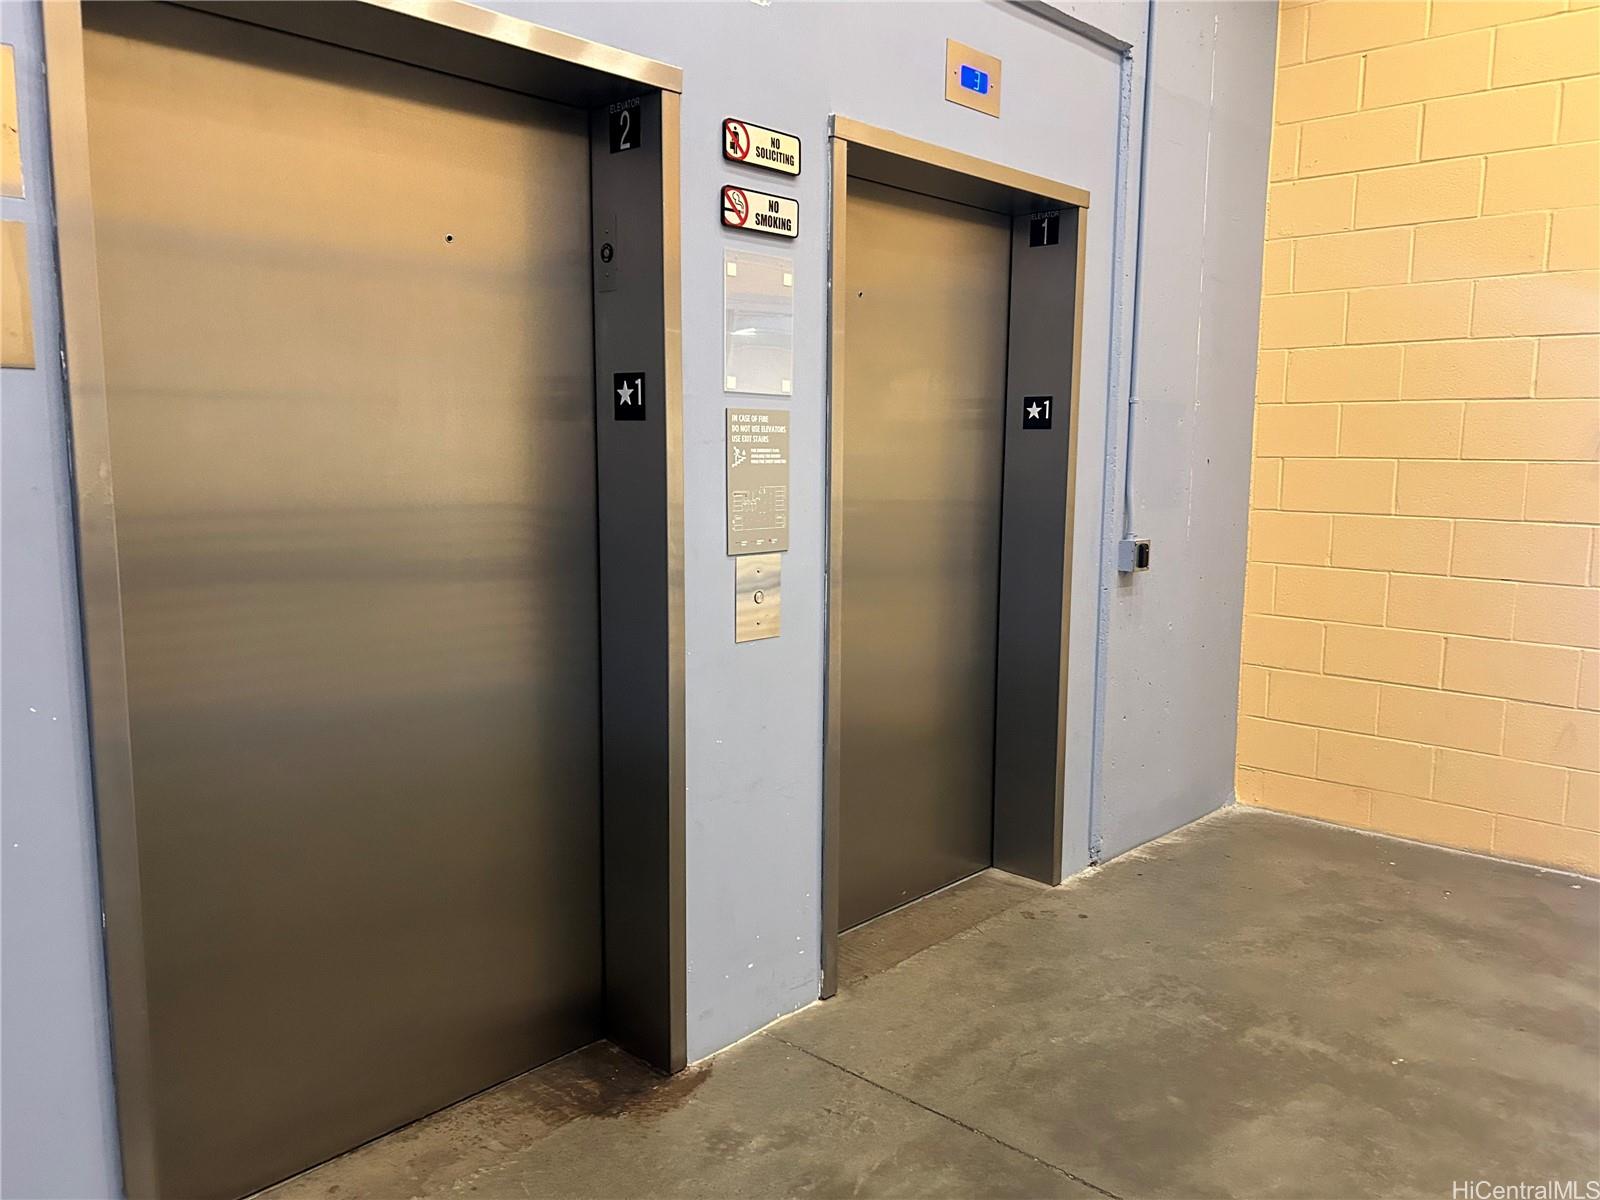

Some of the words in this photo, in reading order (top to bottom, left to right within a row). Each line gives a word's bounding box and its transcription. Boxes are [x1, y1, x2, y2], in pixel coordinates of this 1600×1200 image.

[973, 71, 981, 91] 3
[609, 97, 640, 114] ELEVATOR
[620, 110, 631, 150] 2
[770, 136, 780, 150] NO
[755, 145, 795, 166] SOLICITING
[768, 199, 780, 214] NO
[755, 212, 792, 232] SMOKING
[1041, 218, 1048, 245] 1
[731, 414, 738, 422] IN
[738, 414, 751, 423] CASE
[751, 415, 758, 423] OF
[758, 415, 769, 423] FIRE
[731, 424, 739, 433] DO
[740, 424, 751, 433] NOT
[751, 425, 760, 433] USE
[760, 425, 786, 433] ELEVATORS
[731, 434, 741, 443] USE
[741, 434, 752, 443] EXIT
[752, 435, 769, 443] STAIRS
